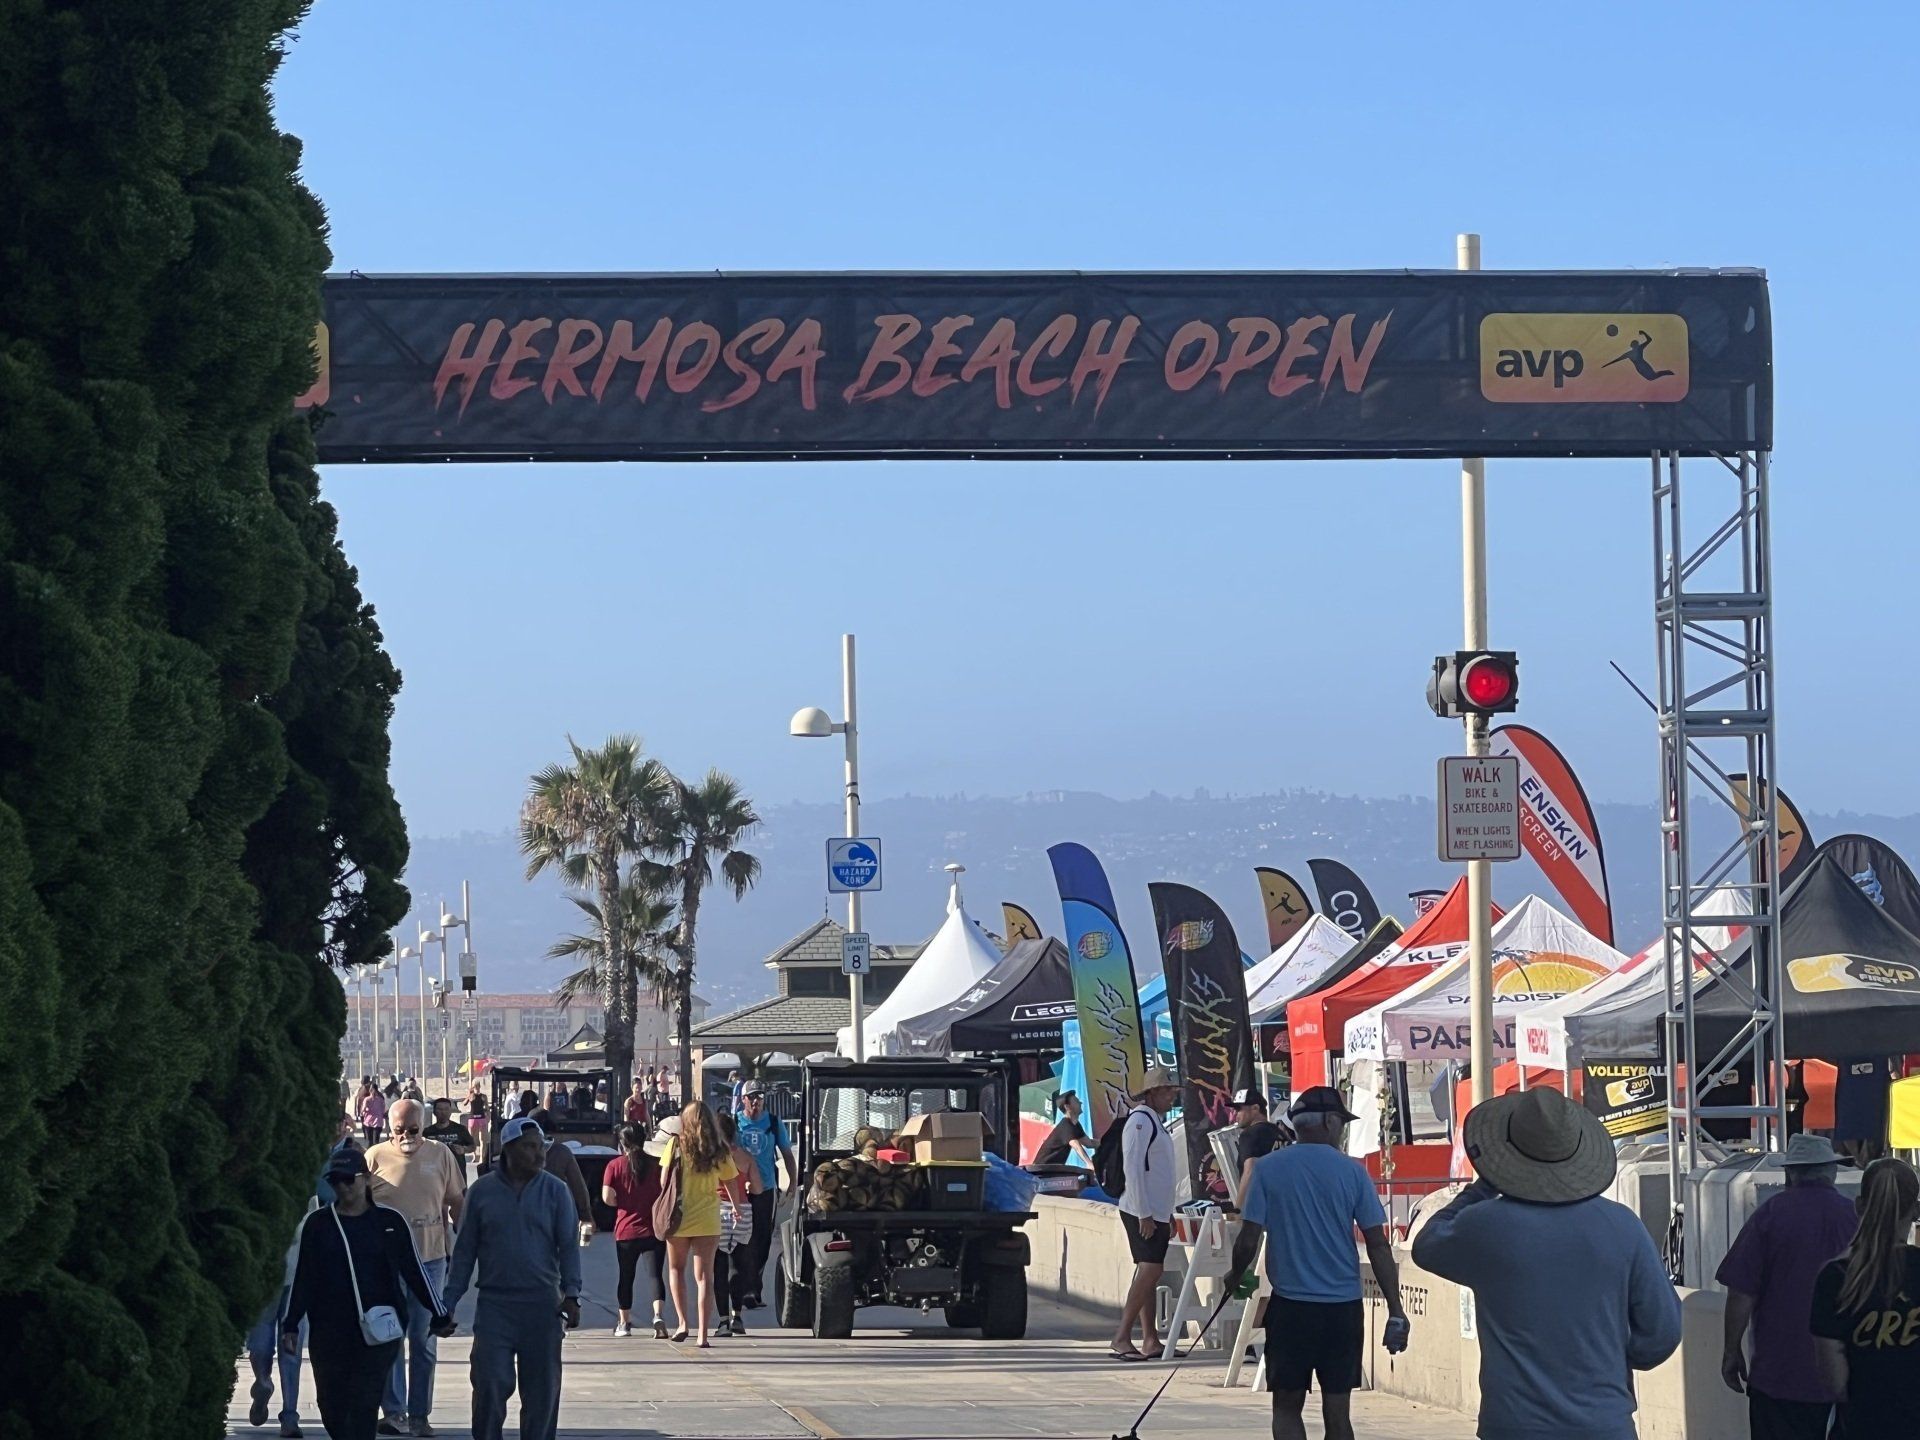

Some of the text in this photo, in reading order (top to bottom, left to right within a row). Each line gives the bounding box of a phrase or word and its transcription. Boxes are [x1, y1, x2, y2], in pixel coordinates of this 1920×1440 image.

[434, 308, 1394, 421] HERMOSA BEACH OPEN
[1495, 344, 1583, 388] avp
[1462, 767, 1501, 783] WALK
[1465, 788, 1499, 798] BIKE &
[1452, 802, 1513, 814] SKATEBOARD
[1456, 826, 1511, 836] WHEN LIGHTS
[1520, 807, 1561, 861] SCREEN
[1453, 839, 1513, 849] ARE FLASHING
[839, 867, 871, 876] HAZARD
[845, 876, 865, 885] ZONE
[852, 954, 861, 970] 8
[1859, 973, 1899, 984] FIRST
[1864, 964, 1915, 983] avp
[1447, 992, 1567, 1004] PADISE
[1631, 1079, 1650, 1090] avp
